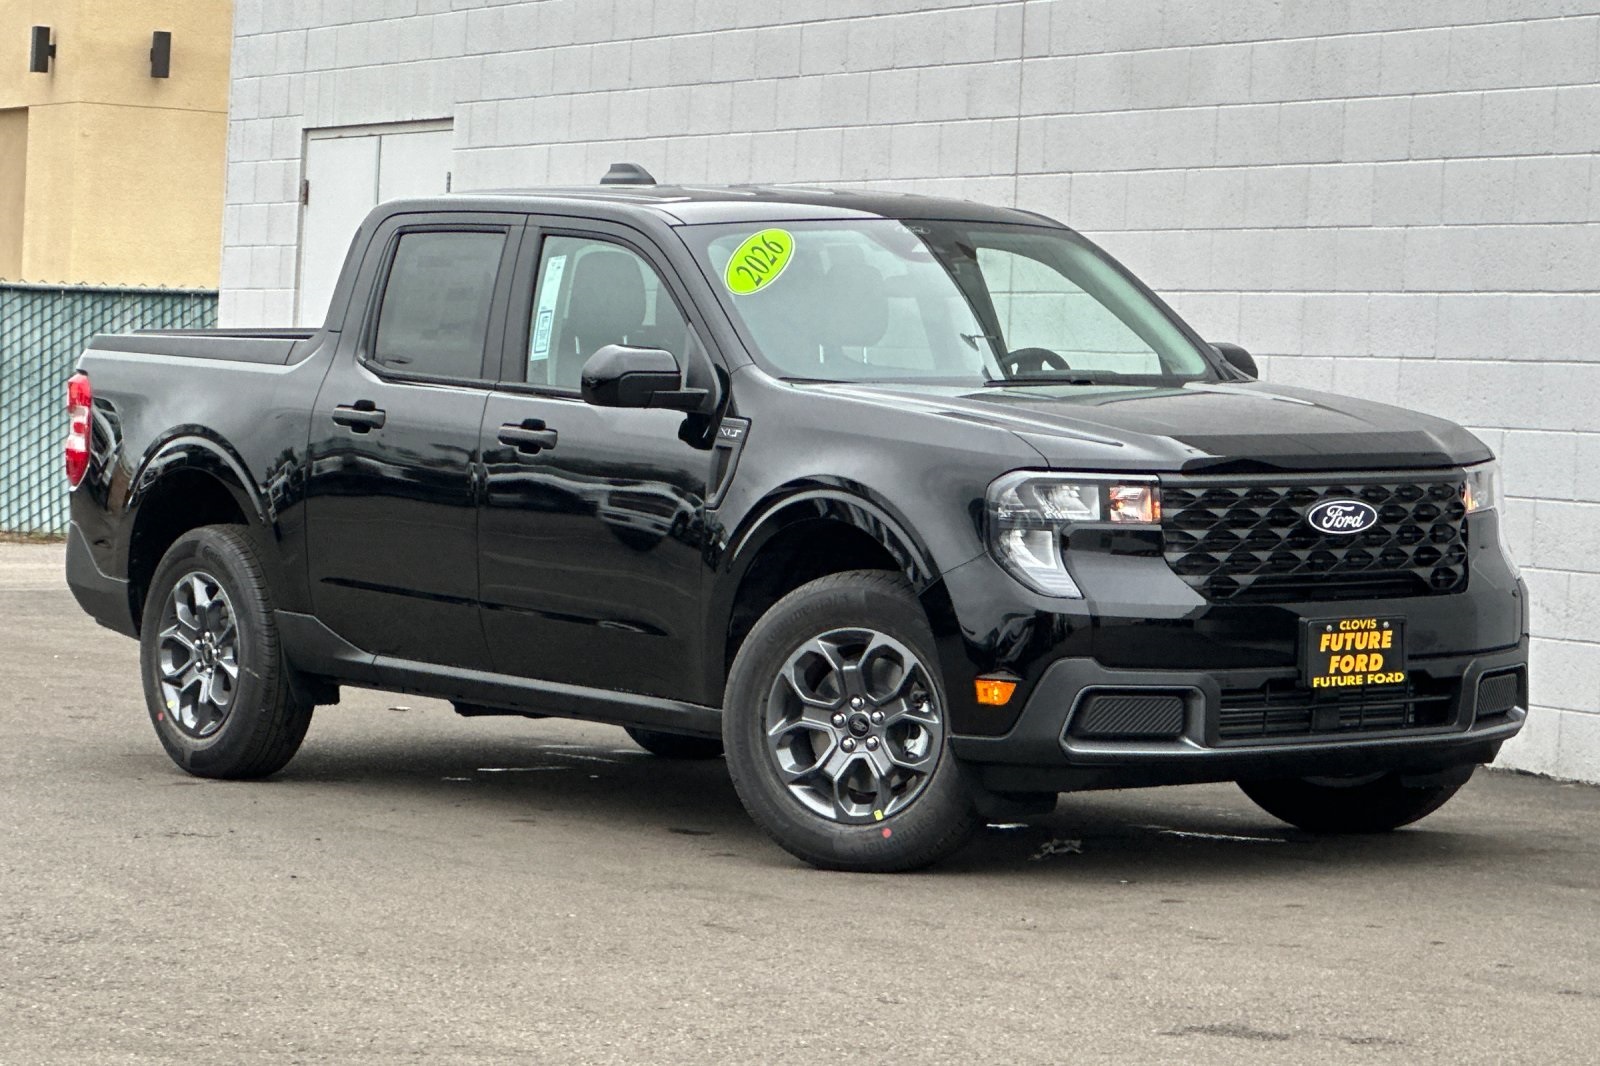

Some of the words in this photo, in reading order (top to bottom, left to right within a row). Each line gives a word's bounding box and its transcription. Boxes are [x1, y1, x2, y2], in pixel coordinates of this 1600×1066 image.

[736, 234, 784, 287] 2026
[1322, 505, 1365, 528] Ford
[1339, 619, 1377, 631] CLOVIS
[1319, 630, 1393, 653] FUTURE
[1328, 653, 1384, 674] FORD
[1312, 675, 1364, 688] FUTURE
[1367, 672, 1405, 685] FORD
